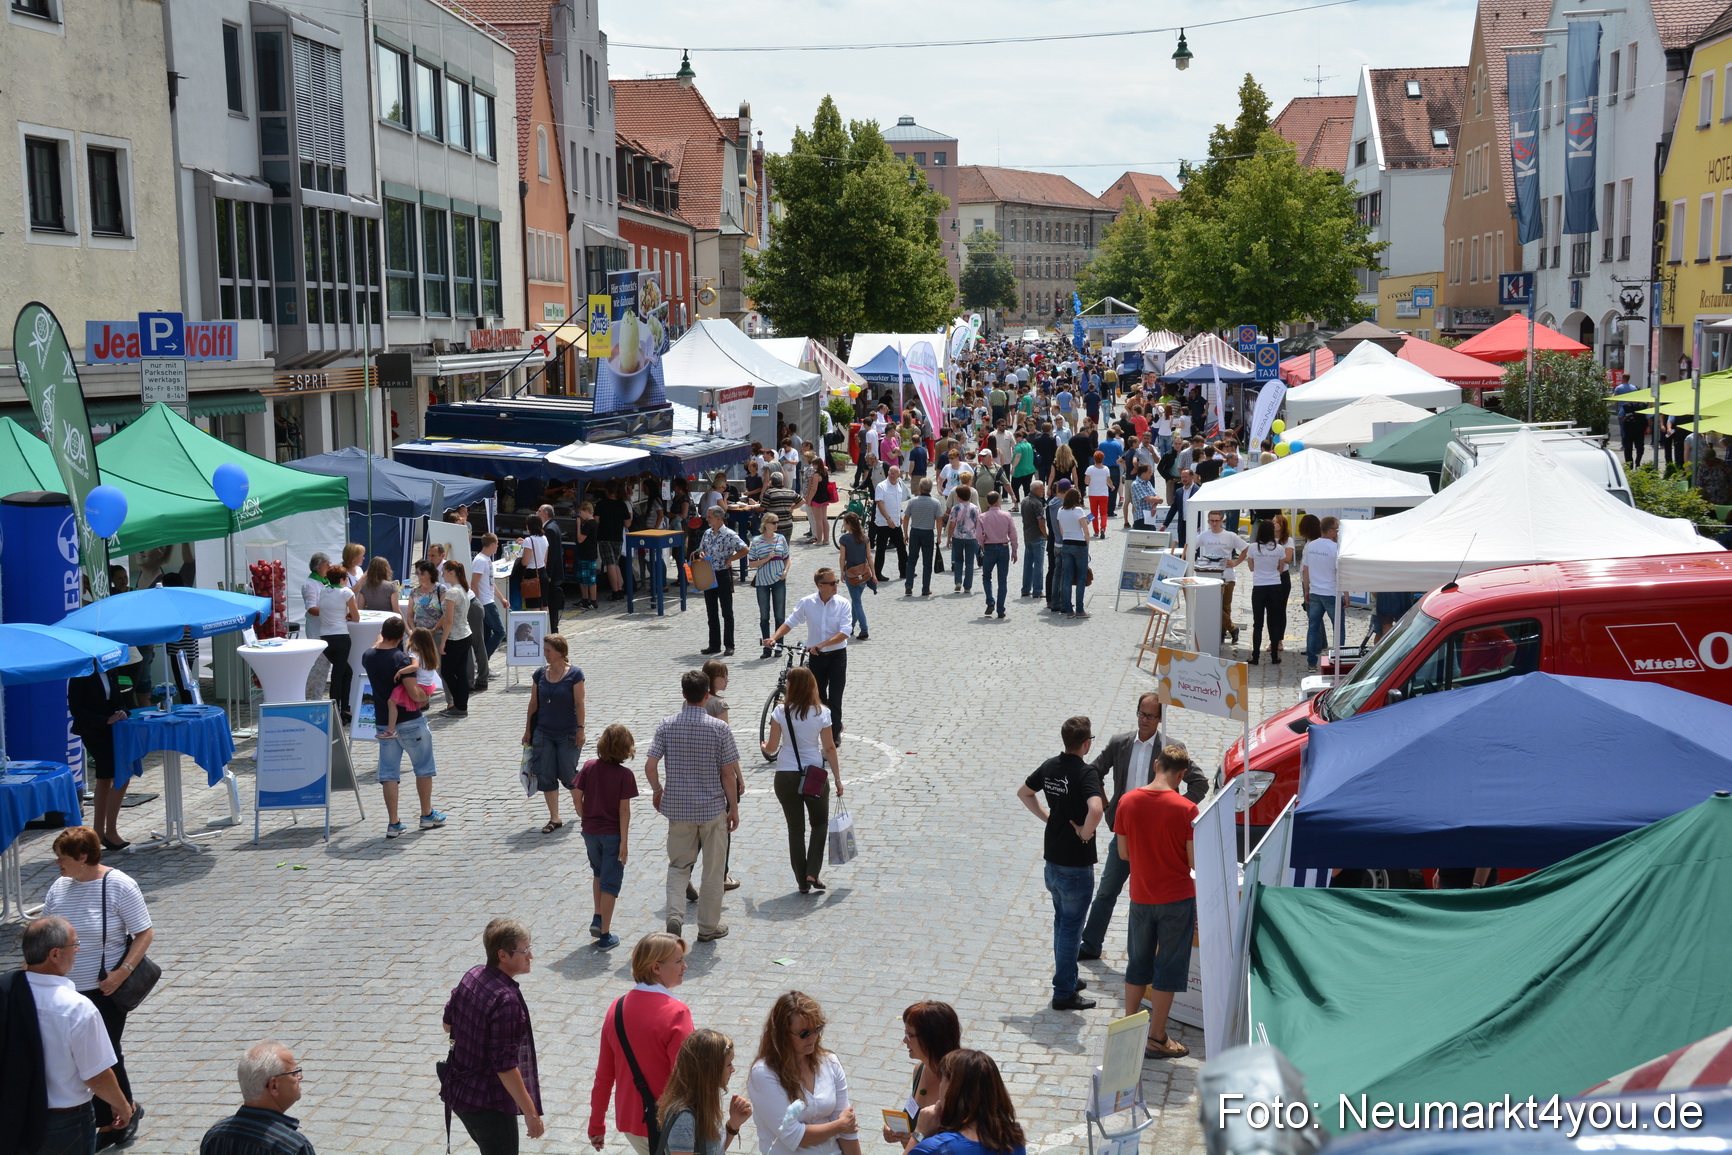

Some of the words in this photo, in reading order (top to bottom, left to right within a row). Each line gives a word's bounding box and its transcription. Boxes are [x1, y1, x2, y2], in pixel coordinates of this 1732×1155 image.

[1567, 96, 1595, 158] K&L
[1513, 121, 1537, 178] K&L
[94, 325, 142, 360] Jea
[185, 325, 233, 358] Wölfl
[149, 317, 174, 351] P
[1241, 343, 1256, 351] TAXI
[165, 361, 177, 369] mit
[1258, 368, 1277, 377] TAXI
[289, 373, 330, 391] ESPRIT
[382, 380, 409, 388] ESPRIT
[752, 403, 769, 411] BER
[1257, 385, 1281, 438] SPANGLER
[63, 569, 81, 612] ER
[1634, 657, 1697, 671] Miele
[1178, 681, 1219, 697] Neumarkt
